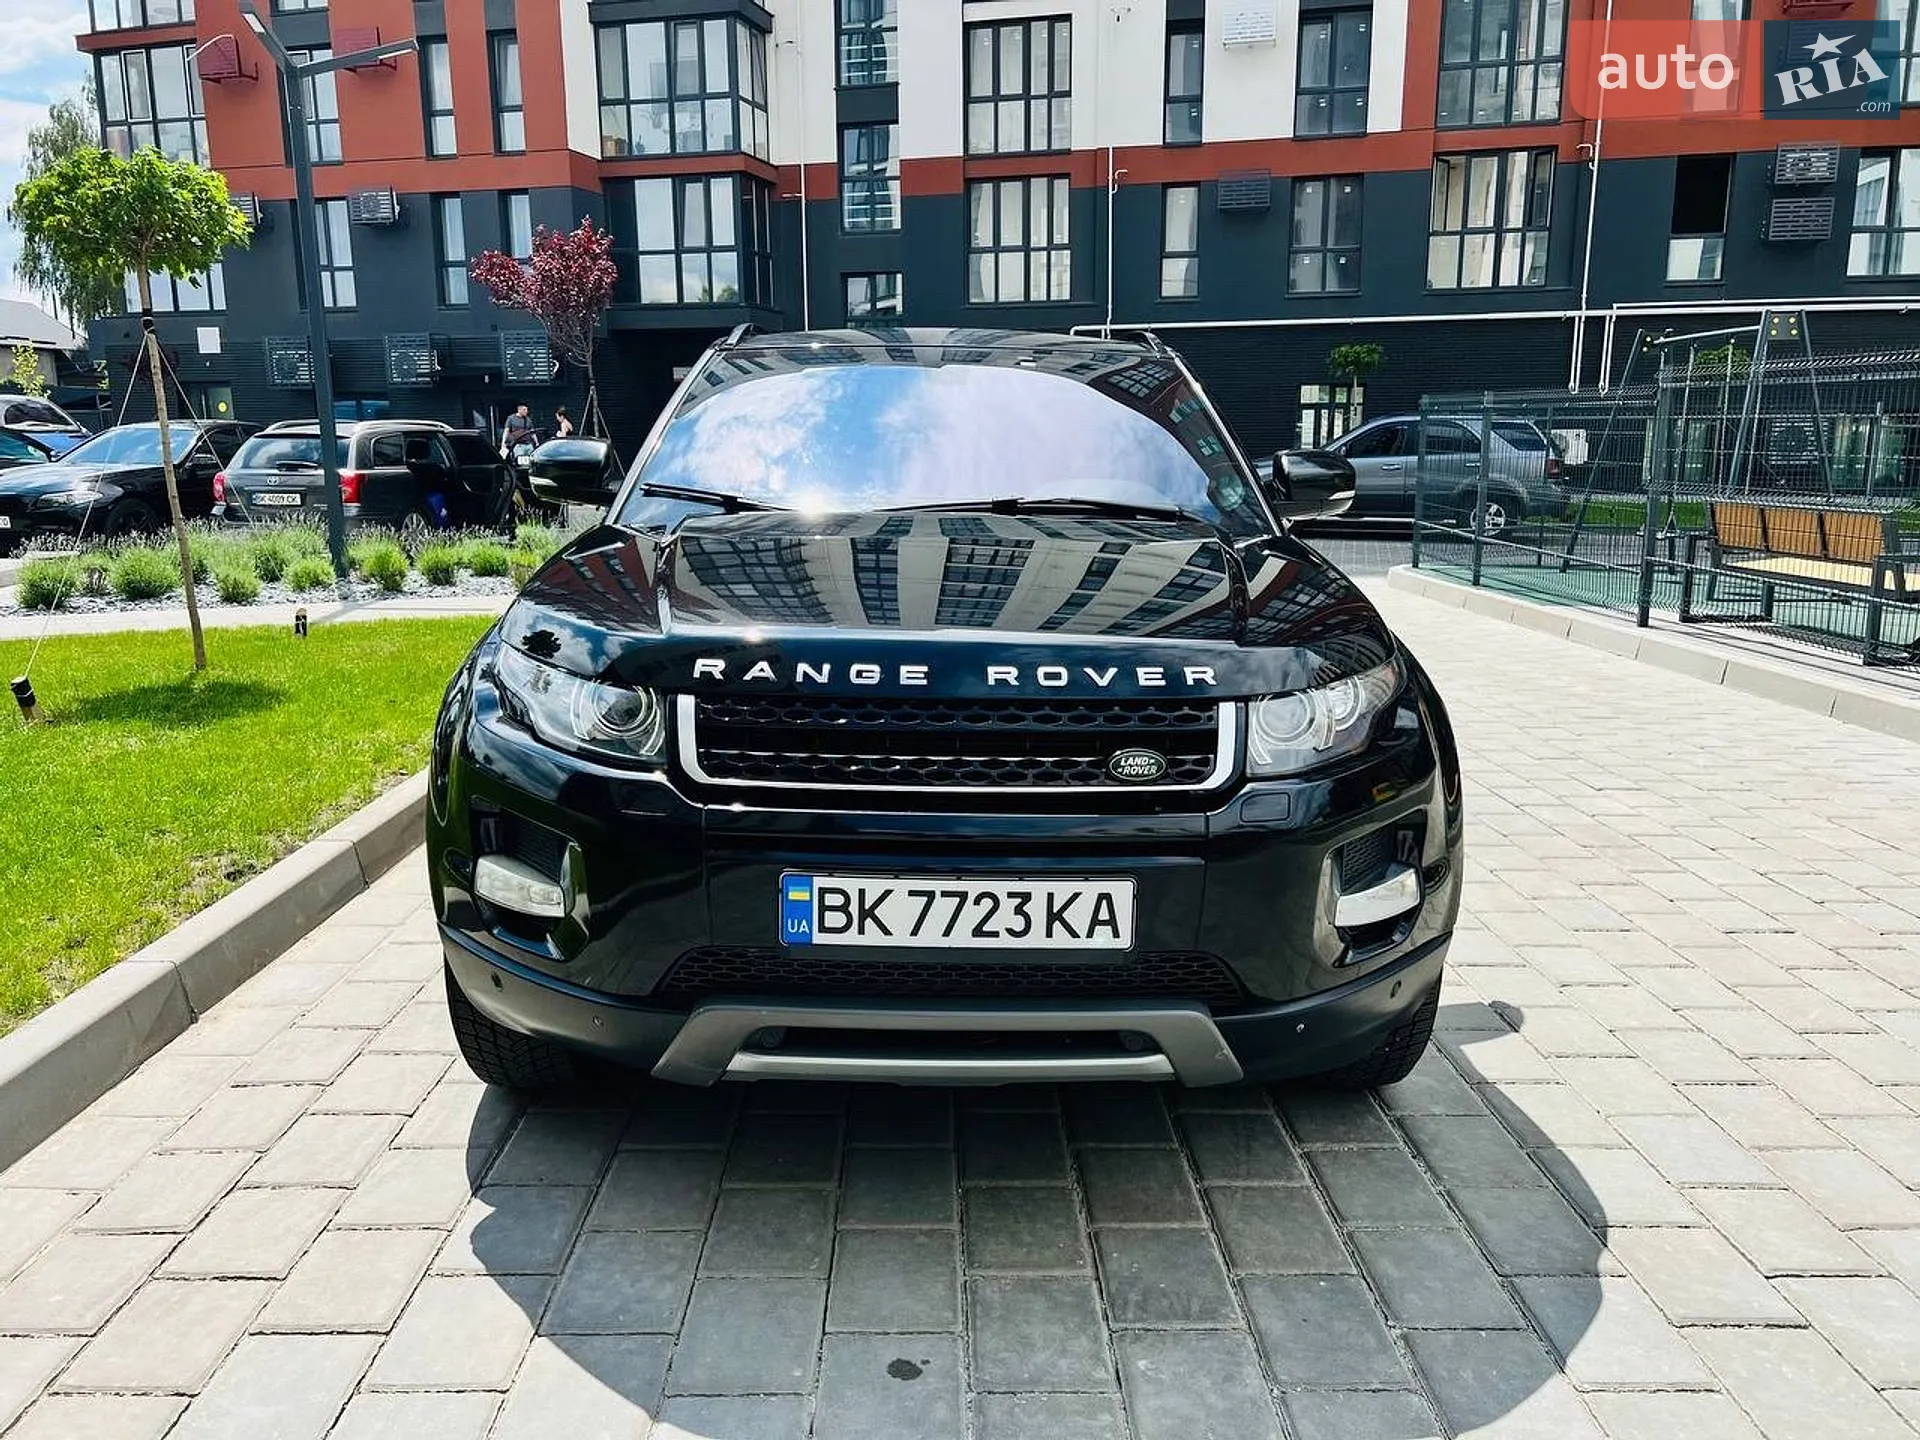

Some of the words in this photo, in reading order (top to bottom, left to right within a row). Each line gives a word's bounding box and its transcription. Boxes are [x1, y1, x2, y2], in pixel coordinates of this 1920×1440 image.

[693, 658, 929, 685] RANGE
[986, 665, 1217, 687] ROVER
[787, 919, 810, 934] UA
[816, 886, 895, 937] BK
[907, 890, 1032, 938] 7723
[1045, 891, 1121, 939] KA
